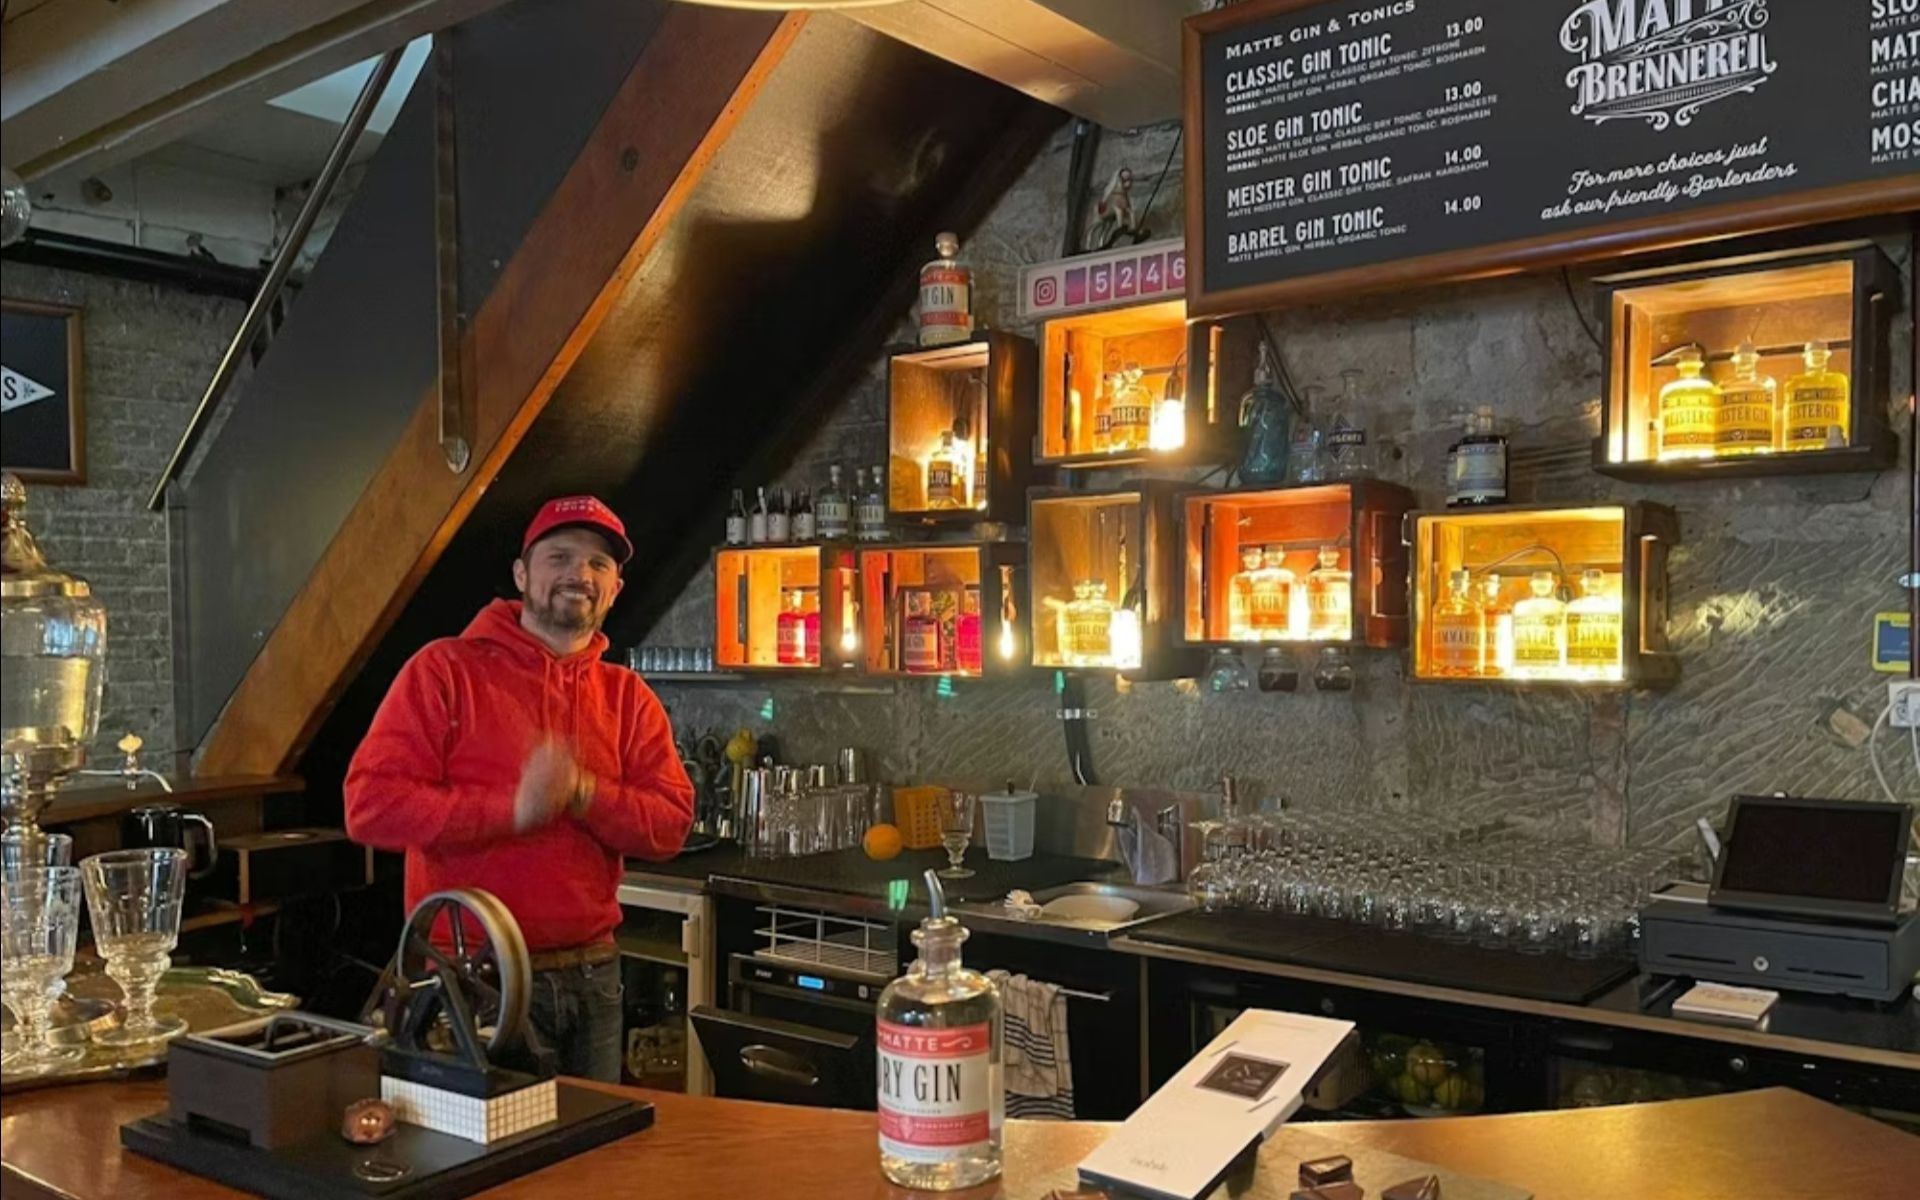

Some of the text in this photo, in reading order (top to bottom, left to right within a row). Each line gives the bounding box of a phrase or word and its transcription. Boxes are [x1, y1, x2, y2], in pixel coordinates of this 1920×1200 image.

[1226, 0, 1416, 59] MATTE GIN & TONICS
[1446, 16, 1483, 38] 13.00
[1226, 33, 1392, 93] CLASSIC GIN TONIC
[1565, 31, 1778, 115] BRENNEREI
[1445, 81, 1482, 102] 13.00
[1227, 102, 1363, 151] SLOE GIN TONIC
[1445, 144, 1482, 165] 14.00
[1568, 135, 1768, 195] For more choices just
[1228, 156, 1392, 209] MEISTER GIN TONIC
[1444, 195, 1482, 215] 14.00
[1541, 161, 1798, 220] ask our friendly Bartenders
[1228, 206, 1384, 255] BARREL GIN TONIC
[3, 376, 17, 401] S
[881, 1031, 938, 1052] MATTE
[913, 1062, 962, 1103] GIN
